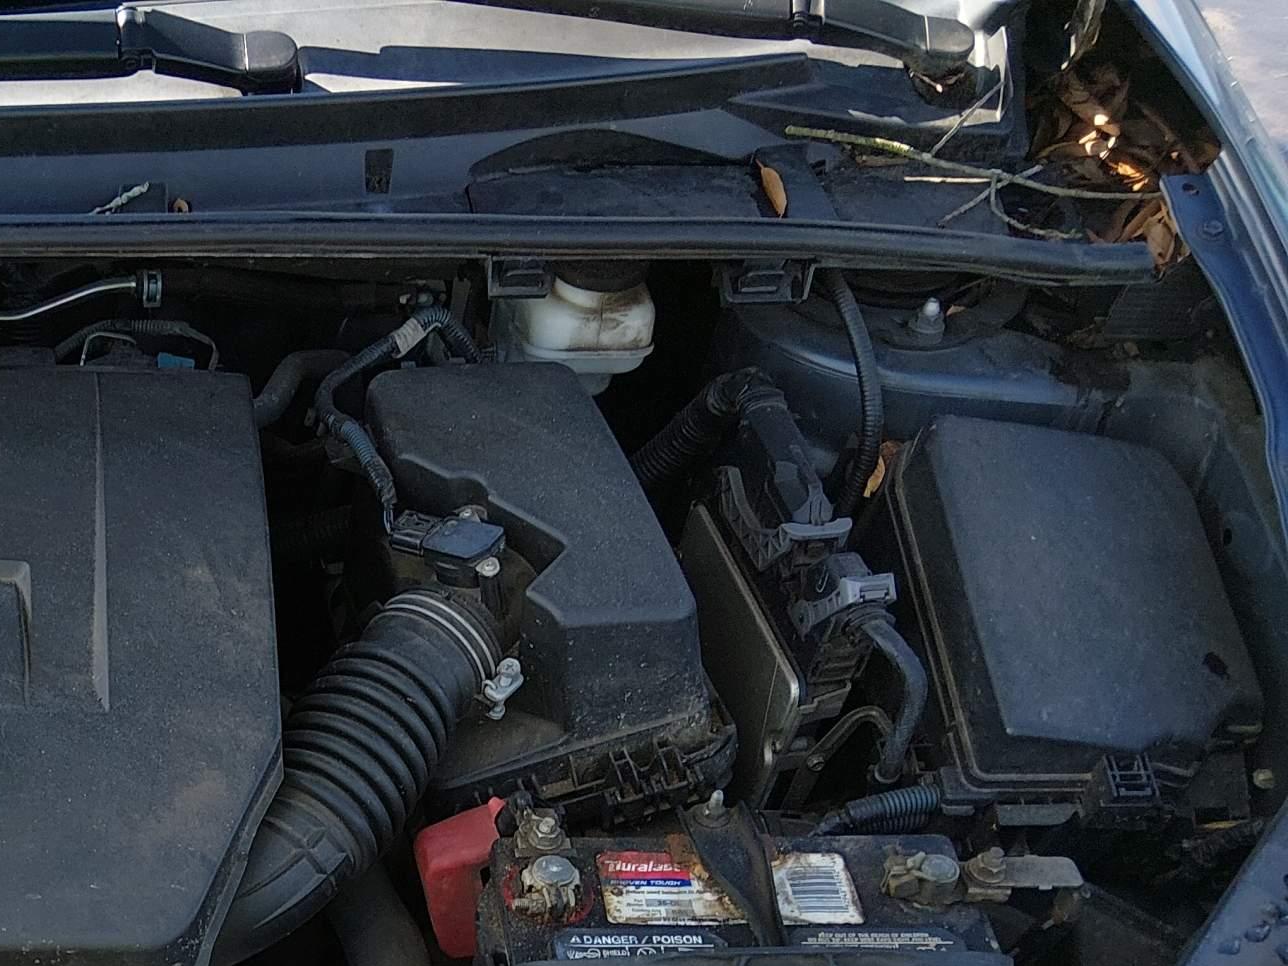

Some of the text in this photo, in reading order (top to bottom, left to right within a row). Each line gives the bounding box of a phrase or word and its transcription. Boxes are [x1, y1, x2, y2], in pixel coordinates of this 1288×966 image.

[650, 879, 681, 887] TOUGH
[583, 935, 639, 945] DANGER
[652, 935, 703, 945] POISON
